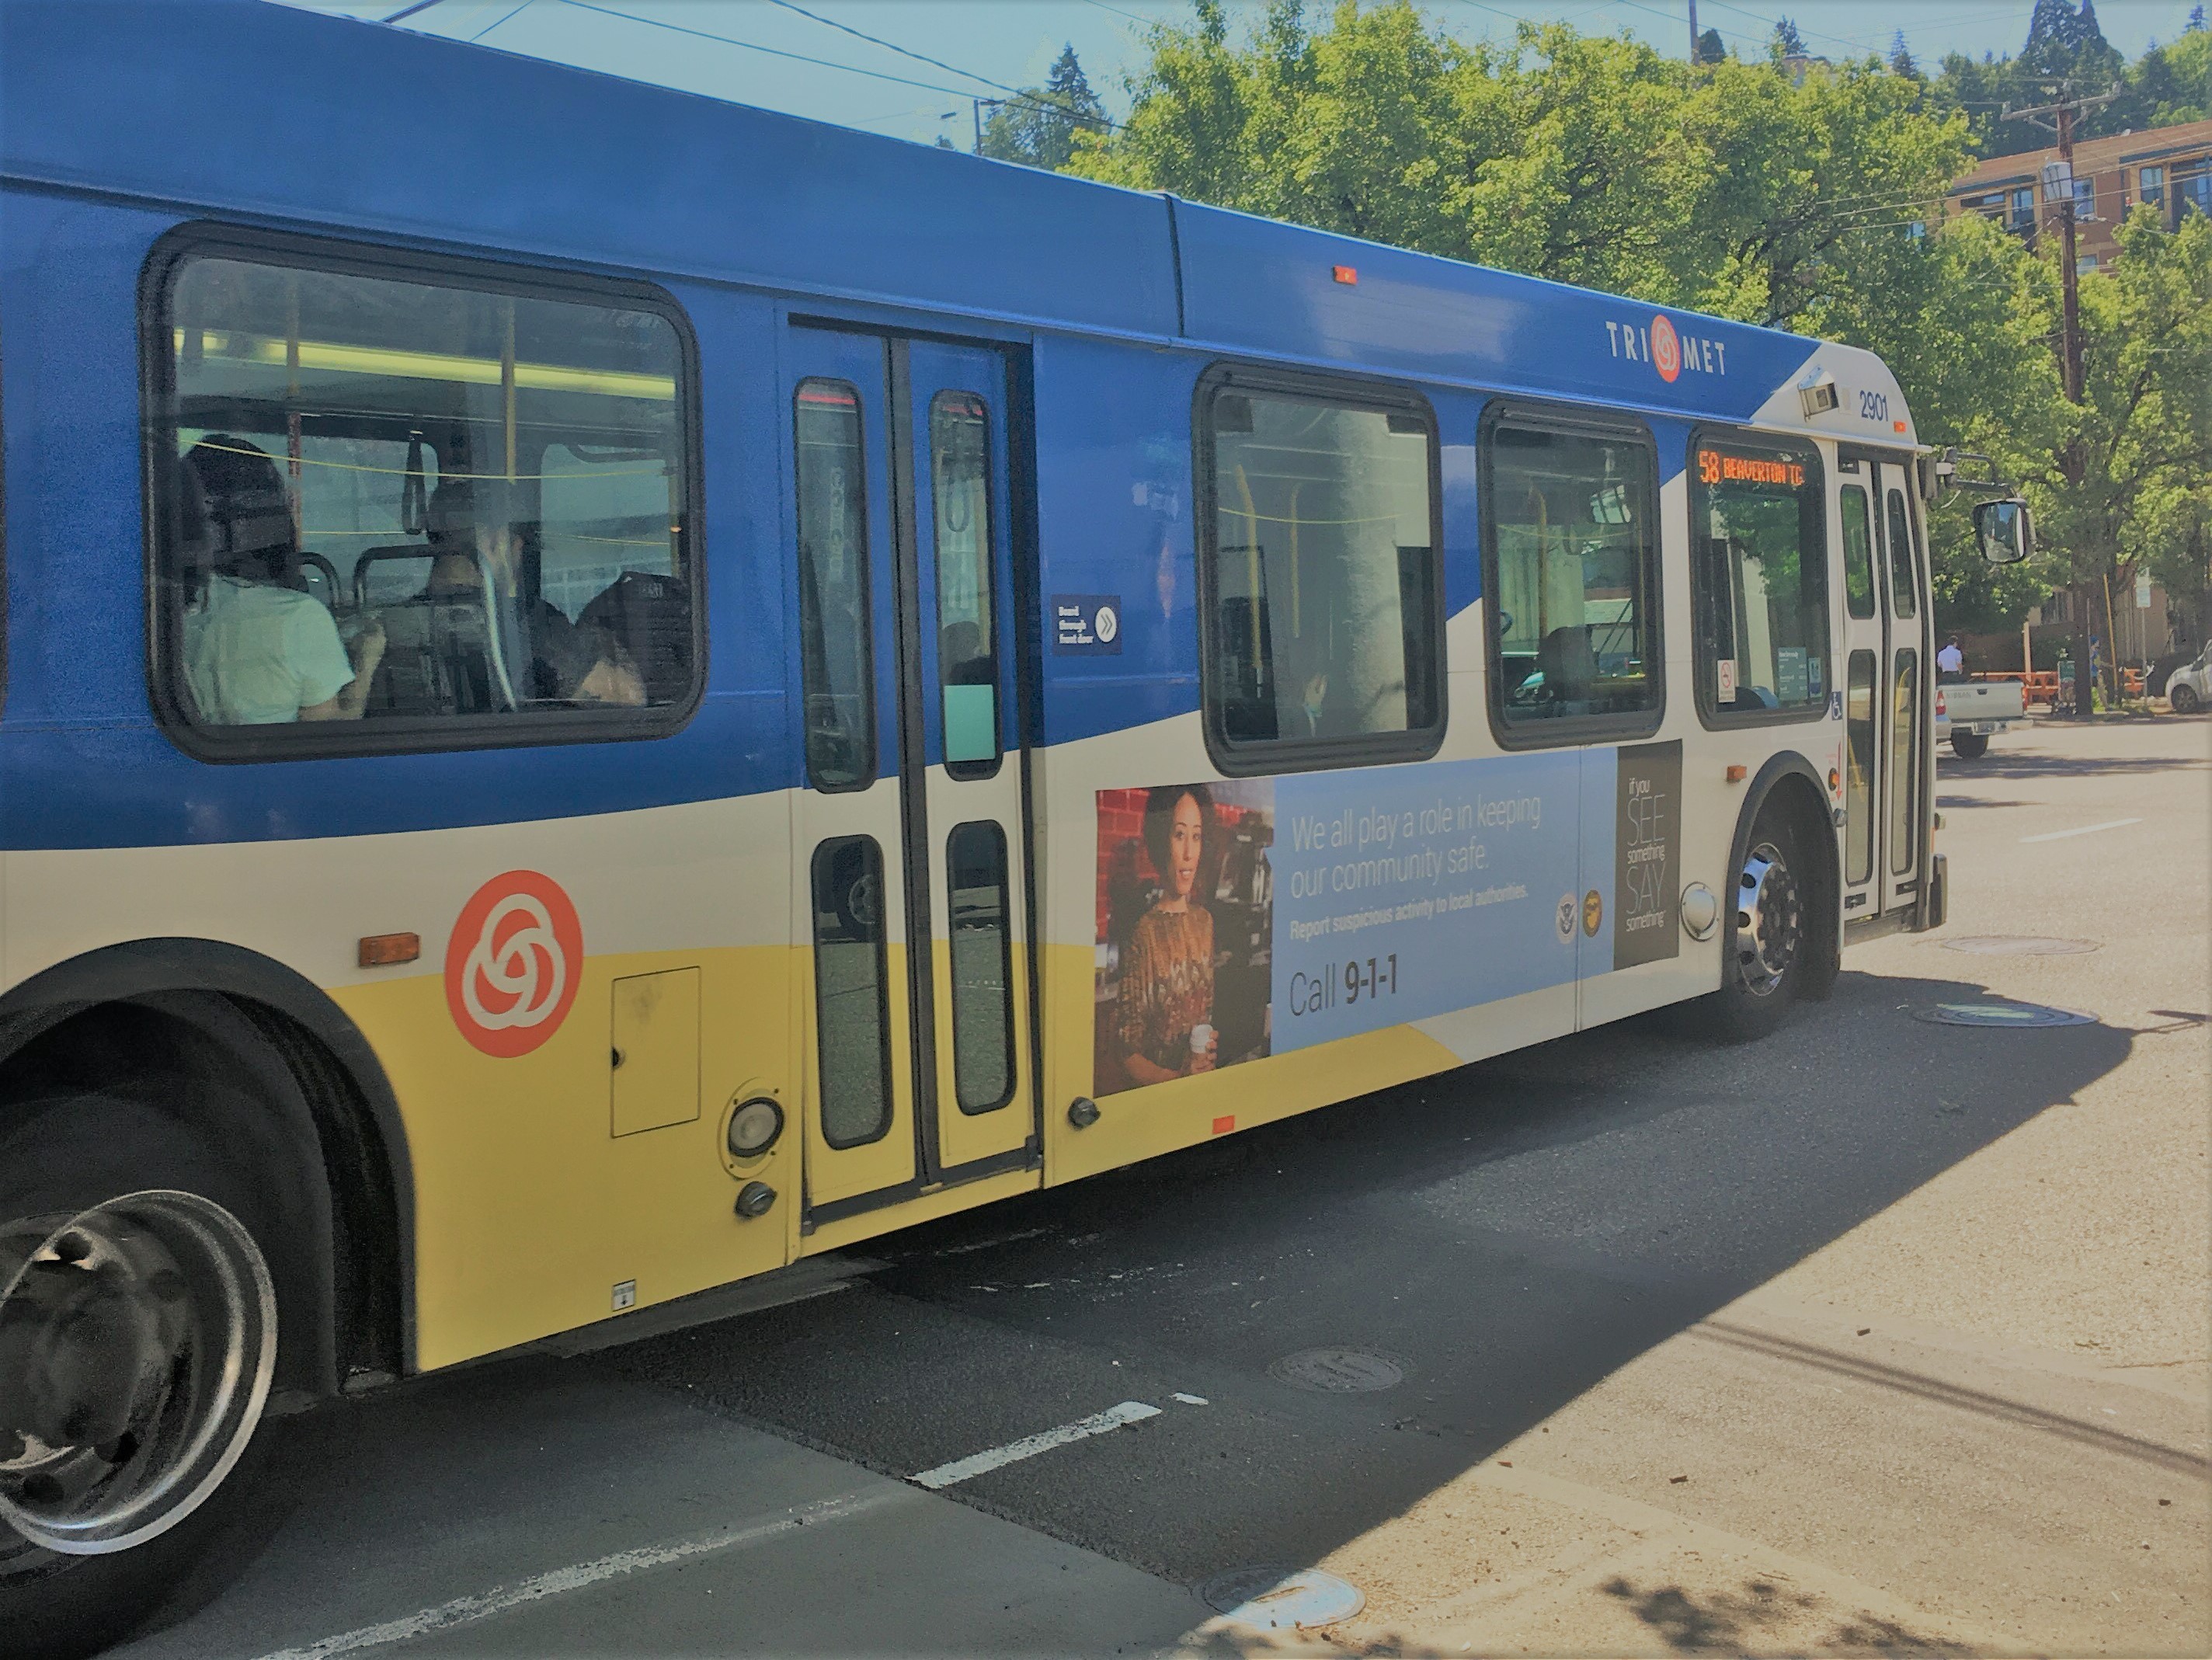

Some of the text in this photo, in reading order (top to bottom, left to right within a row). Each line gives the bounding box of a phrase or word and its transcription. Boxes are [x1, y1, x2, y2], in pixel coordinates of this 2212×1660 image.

[1605, 321, 1725, 375] TRI MET
[1859, 389, 1889, 422] 2901
[1699, 450, 1804, 485] 58 BEAVERTON TC
[1635, 779, 1650, 797] you
[1292, 789, 1541, 852] We all play a role in keeping
[1627, 794, 1665, 847] SEE
[1291, 835, 1489, 899] our community safe.
[1627, 844, 1665, 865] something
[1626, 861, 1667, 915] SAY
[1290, 915, 1330, 942] Report
[1437, 896, 1448, 914] to
[1449, 888, 1473, 911] local
[1626, 910, 1664, 932] something
[1289, 953, 1397, 1017] Call 9-1-1
